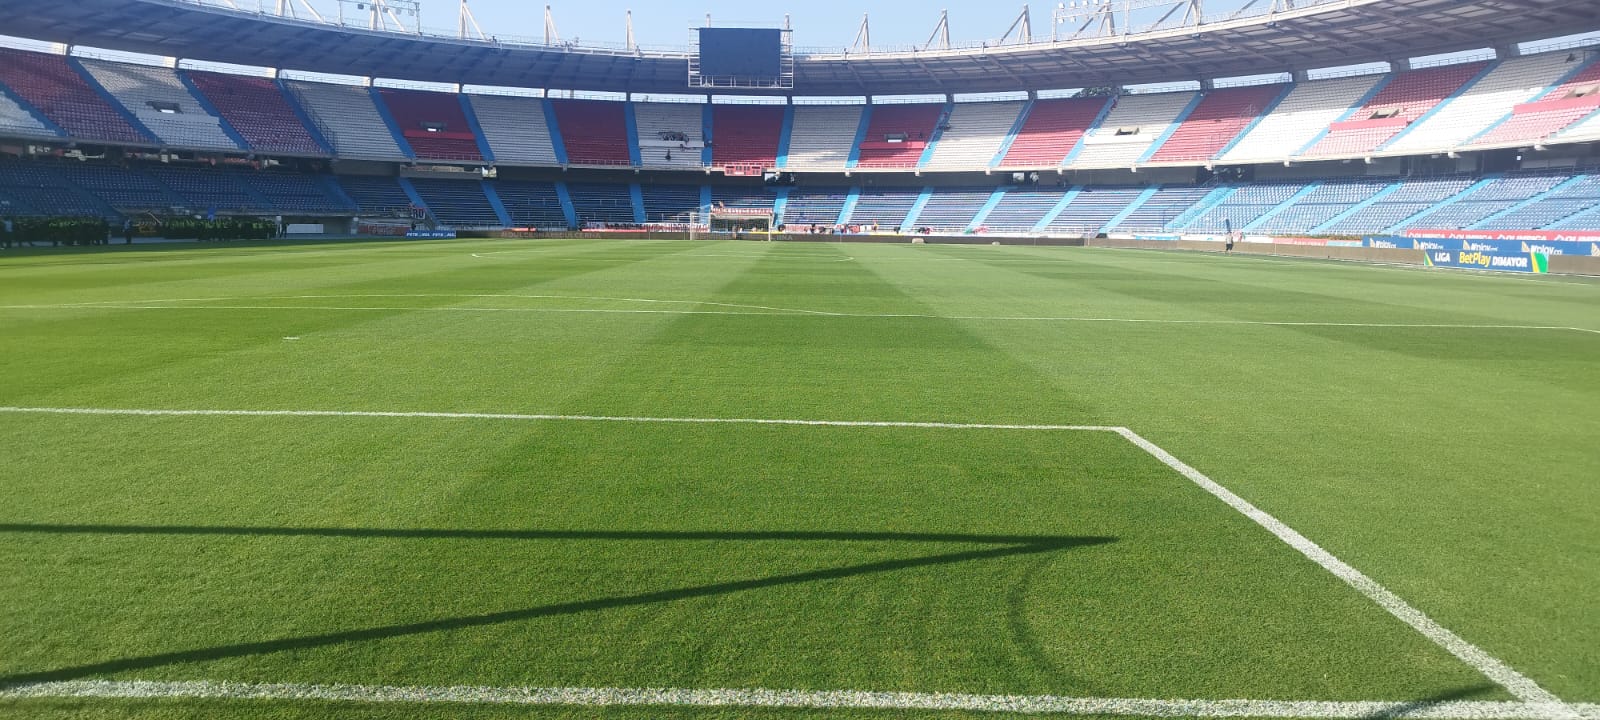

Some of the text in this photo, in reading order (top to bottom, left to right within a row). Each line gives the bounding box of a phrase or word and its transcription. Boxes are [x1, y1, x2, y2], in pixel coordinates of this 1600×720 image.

[1434, 251, 1528, 267] LIGA BetPlay DIMAYOR
